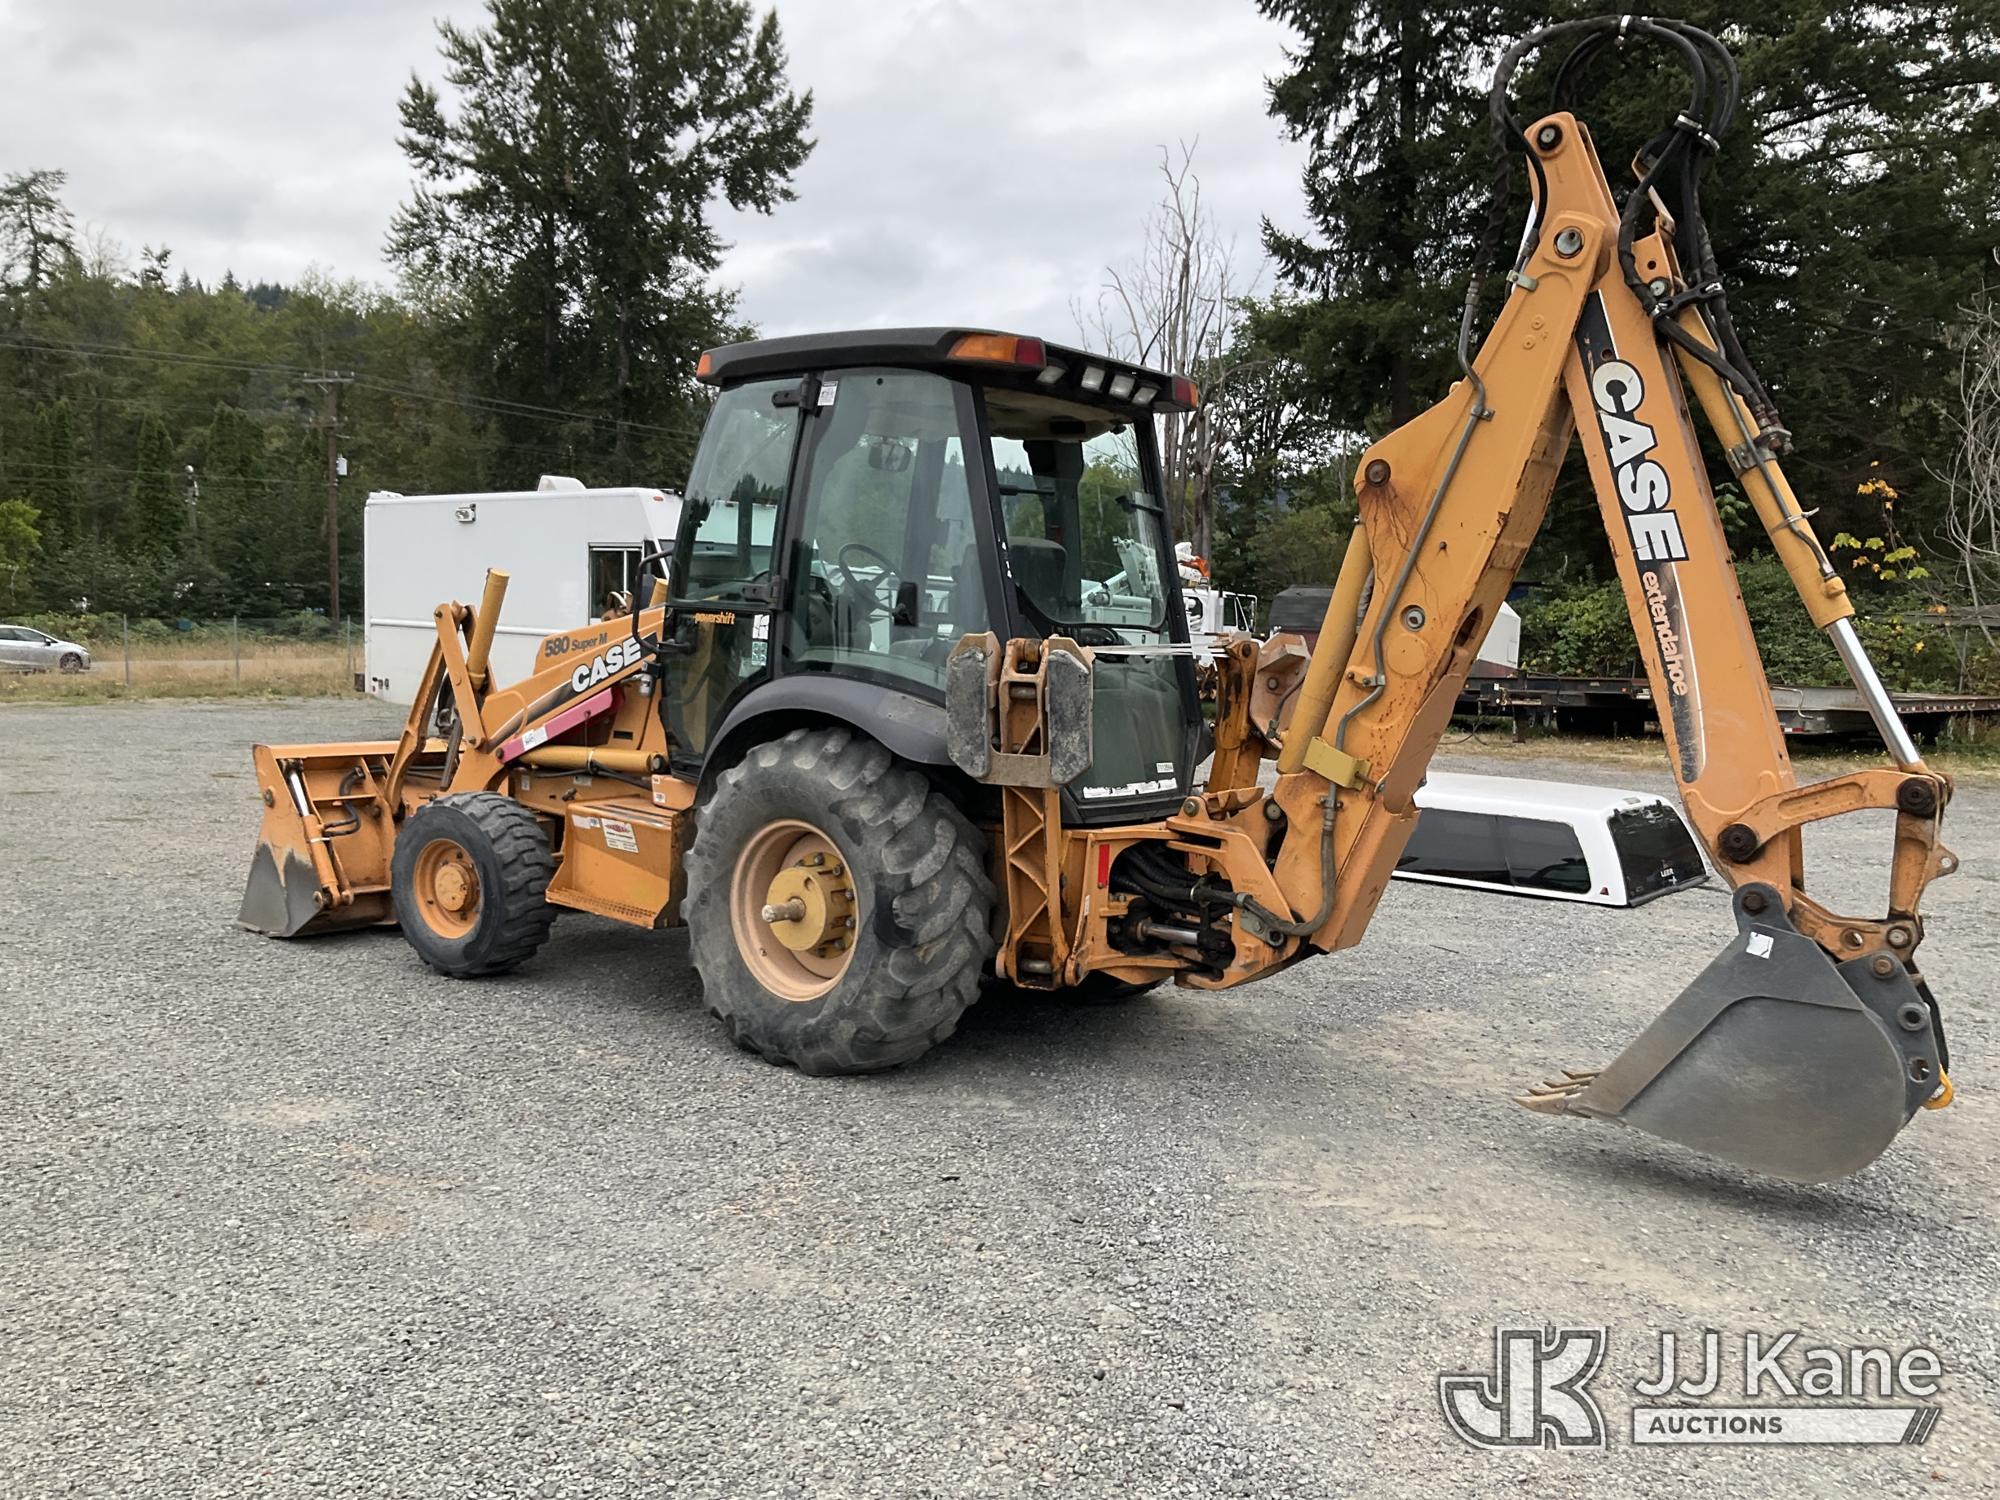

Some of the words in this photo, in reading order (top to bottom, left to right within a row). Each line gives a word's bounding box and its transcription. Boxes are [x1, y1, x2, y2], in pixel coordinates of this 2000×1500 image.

[1592, 361, 1686, 561] CASE
[544, 636, 570, 657] 580
[571, 637, 598, 652] Super
[599, 632, 608, 644] M
[694, 611, 735, 625] powershift
[1642, 571, 1688, 696] extendahoe
[571, 636, 641, 693] CASE
